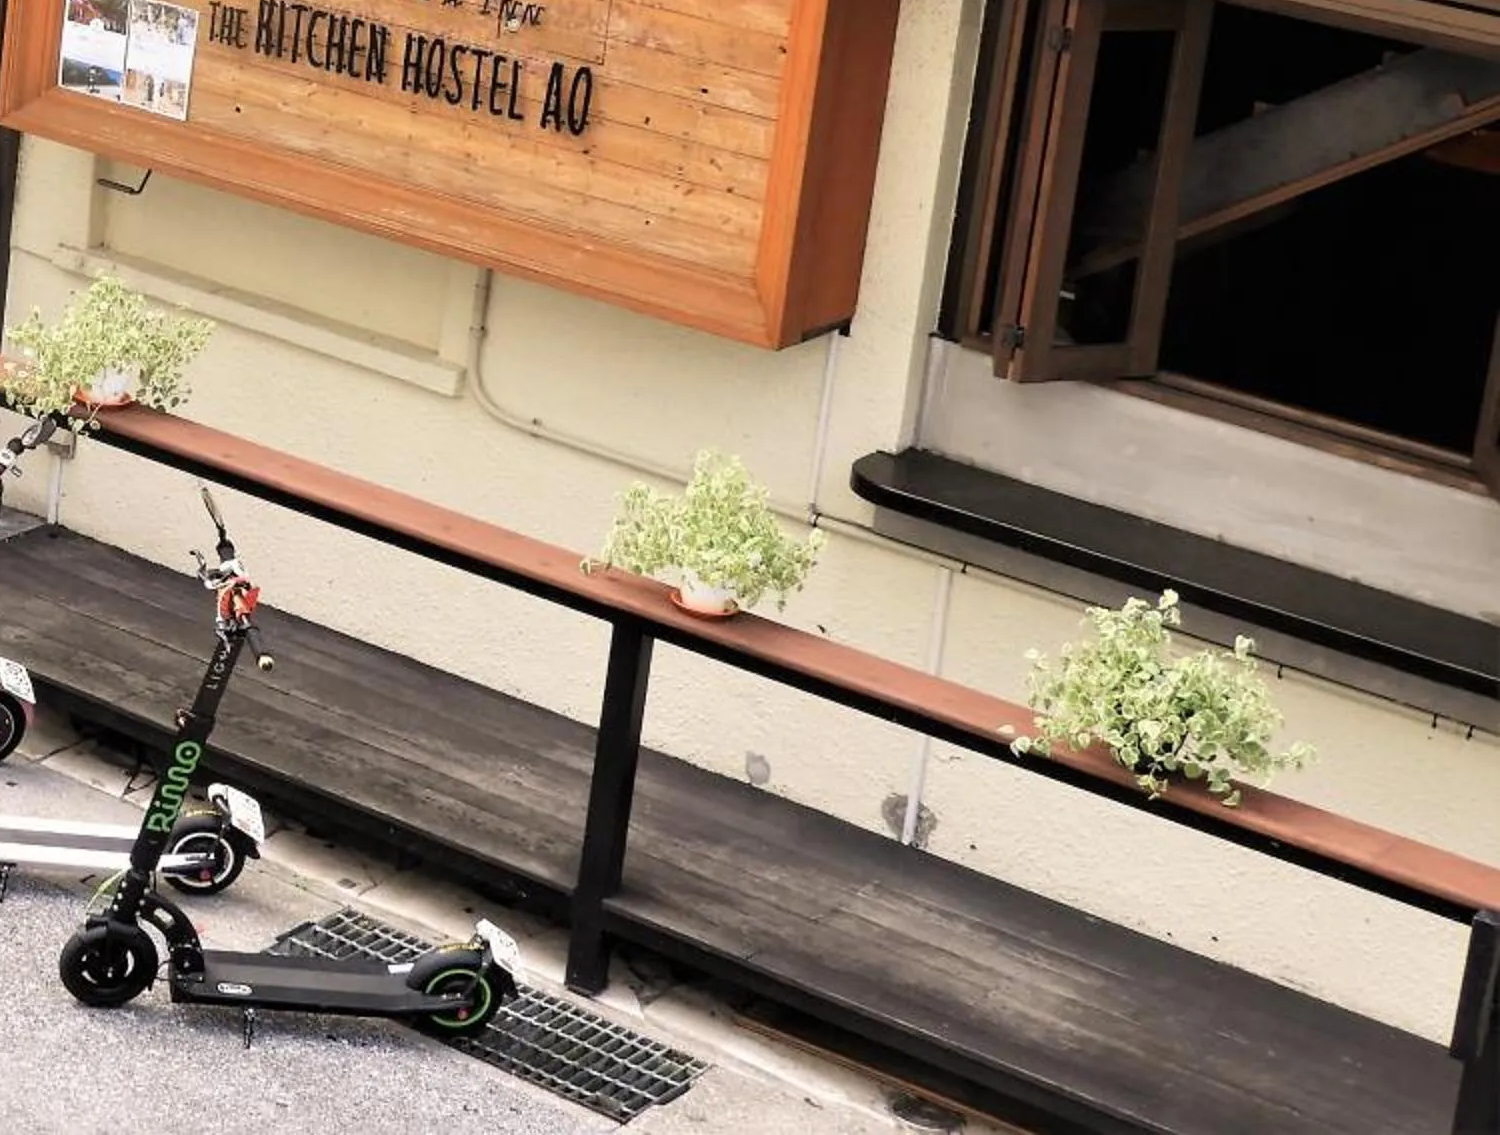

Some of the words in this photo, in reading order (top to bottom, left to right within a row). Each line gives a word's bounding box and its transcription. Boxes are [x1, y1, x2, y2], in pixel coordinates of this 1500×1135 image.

[209, 0, 250, 51] THE
[401, 32, 525, 122] HOSTEL
[539, 61, 595, 137] AO
